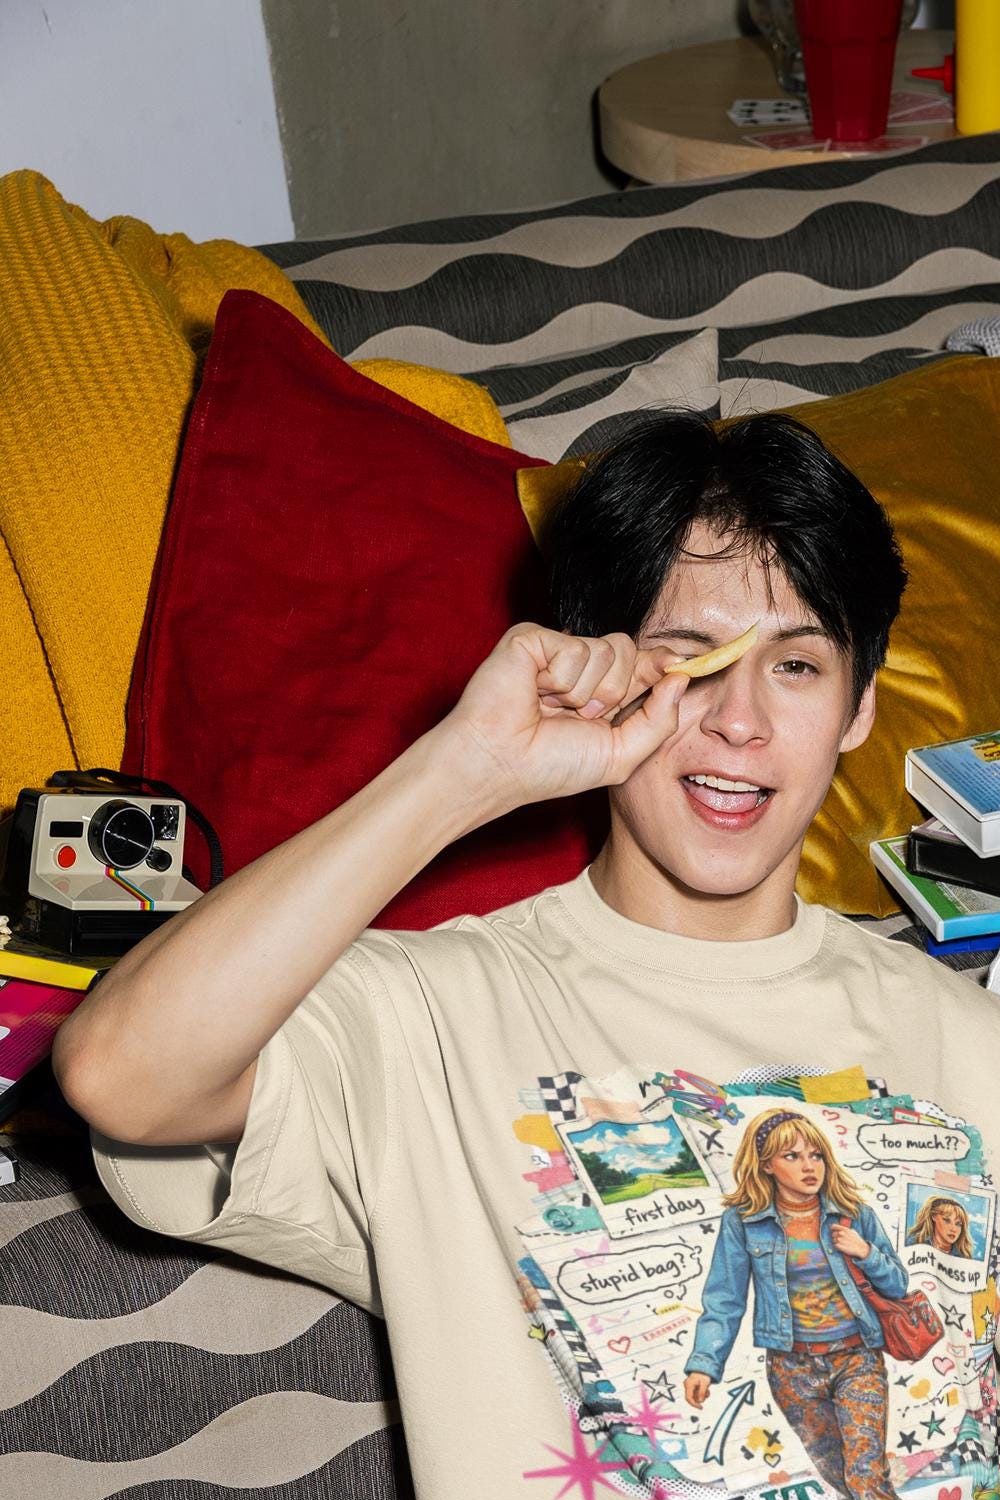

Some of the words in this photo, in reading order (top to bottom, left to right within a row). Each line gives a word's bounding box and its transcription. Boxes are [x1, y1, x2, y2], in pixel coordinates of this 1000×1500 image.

[879, 1132, 902, 1149] too
[906, 1134, 959, 1151] much??
[624, 1200, 665, 1226] first
[664, 1193, 705, 1216] day
[579, 1263, 641, 1292] stupid
[638, 1252, 687, 1278] bag?
[907, 1250, 937, 1267] don't
[936, 1262, 966, 1283] mess
[968, 1271, 981, 1287] up
